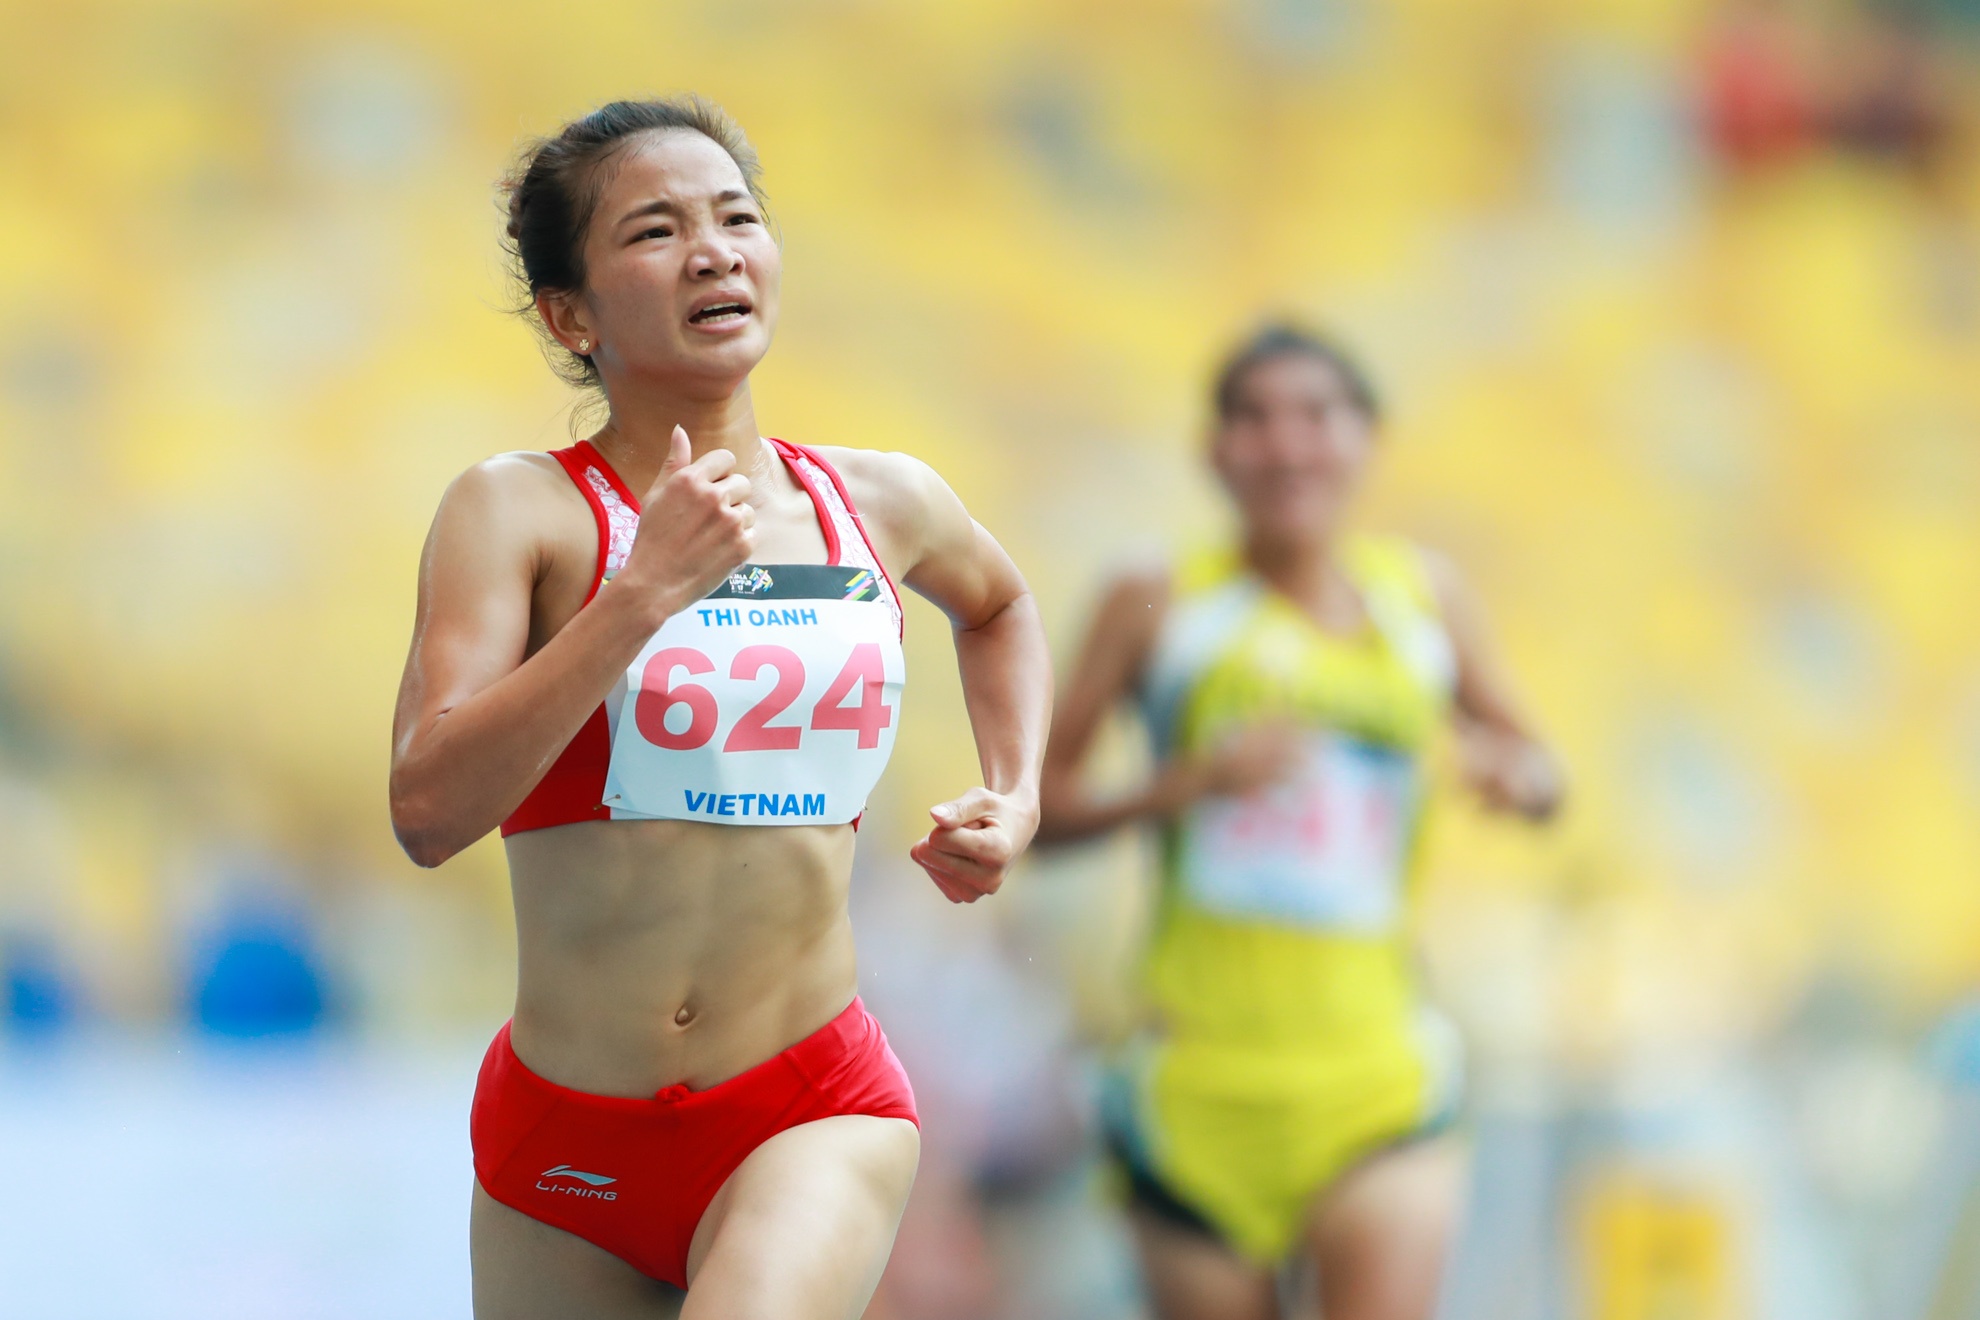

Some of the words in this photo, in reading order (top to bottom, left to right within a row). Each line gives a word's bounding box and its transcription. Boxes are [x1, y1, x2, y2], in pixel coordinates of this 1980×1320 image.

[697, 608, 741, 627] THI
[748, 608, 818, 627] OANH
[634, 642, 892, 753] 624
[684, 789, 826, 816] VIETNAM
[535, 1180, 618, 1201] LI-NING
